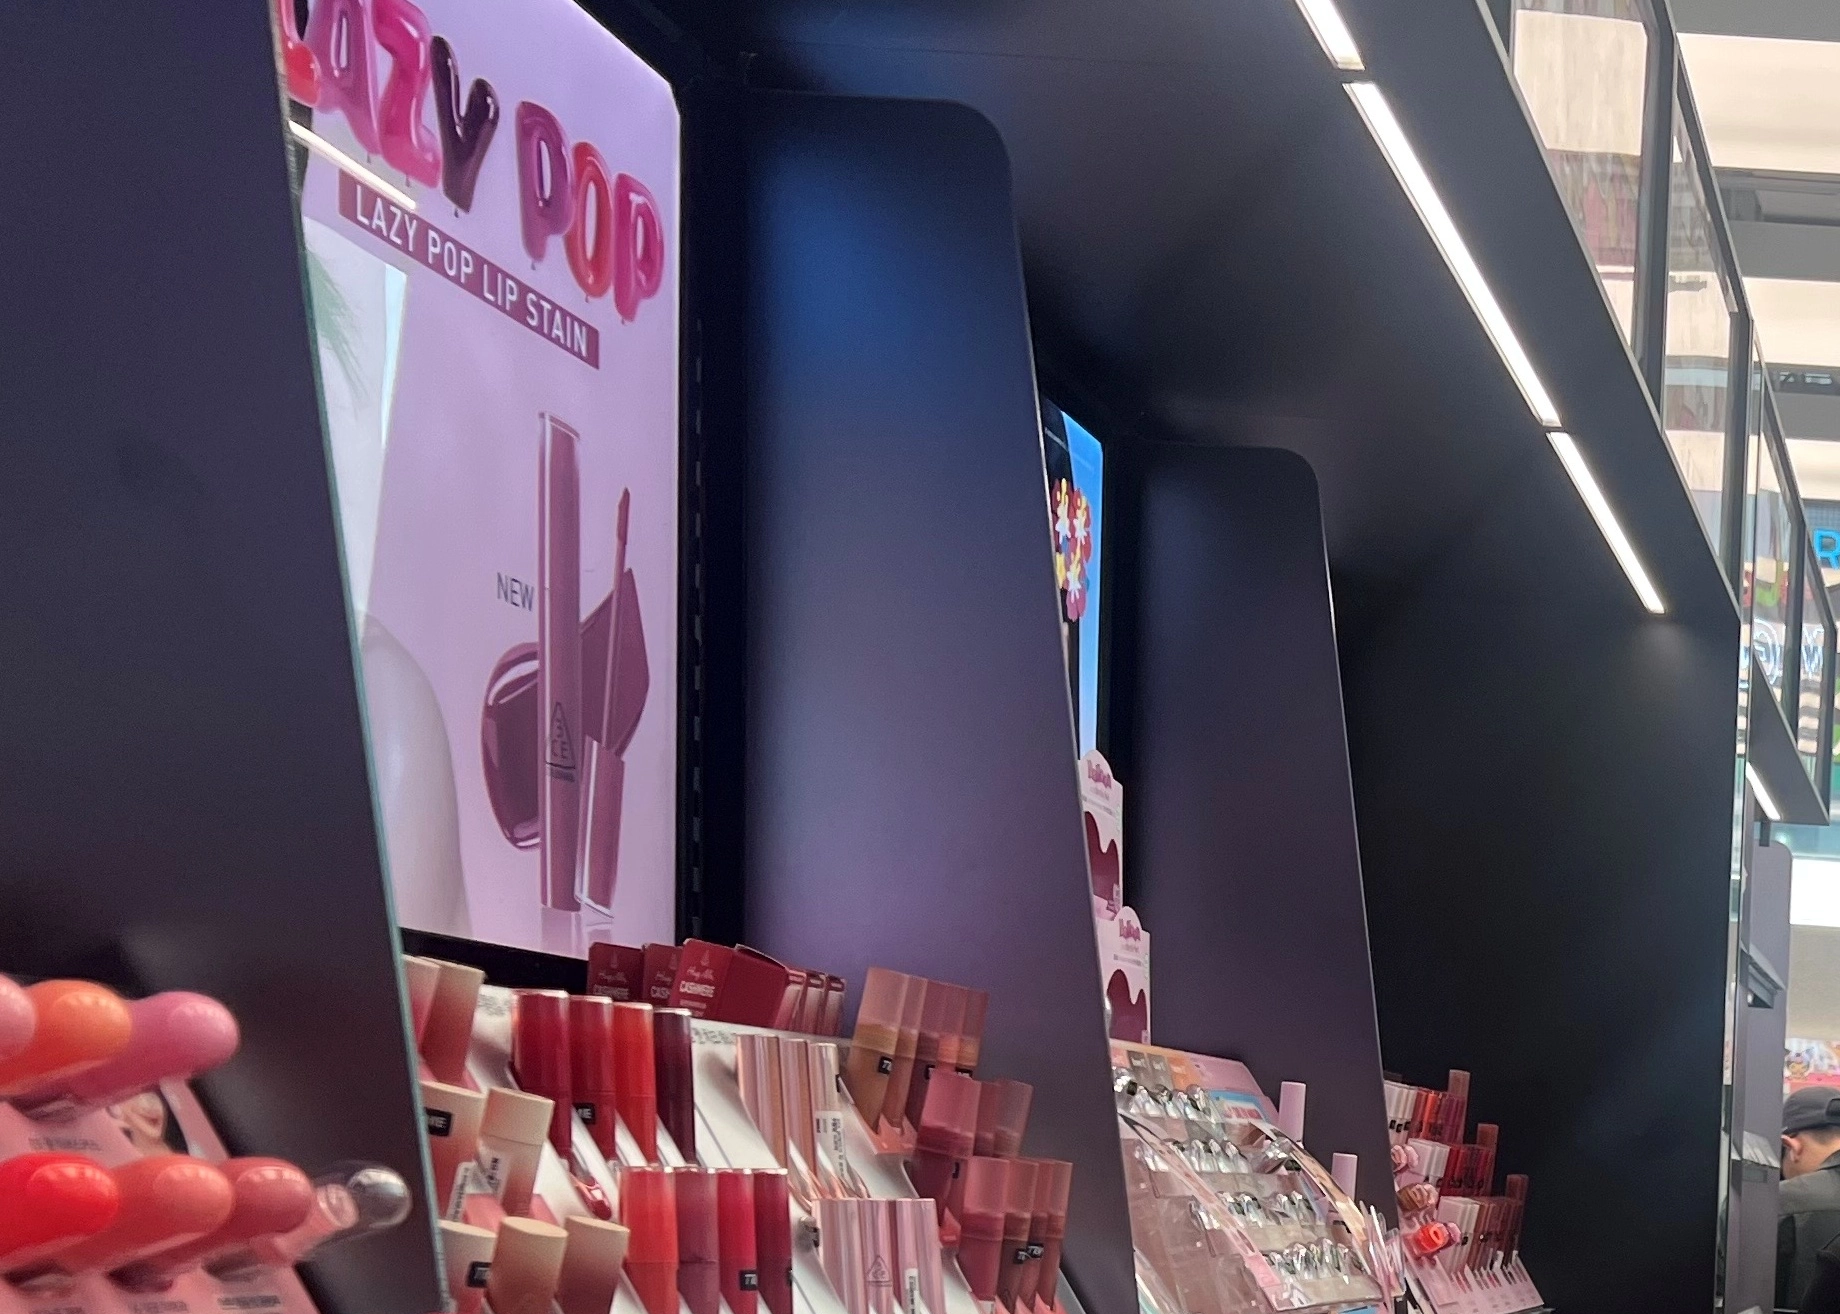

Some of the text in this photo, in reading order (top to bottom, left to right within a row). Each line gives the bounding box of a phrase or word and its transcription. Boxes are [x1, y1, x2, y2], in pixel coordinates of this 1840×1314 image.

[356, 185, 588, 357] LAZY POP LIP STAIN
[515, 101, 664, 324] POP
[497, 571, 535, 612] NEW
